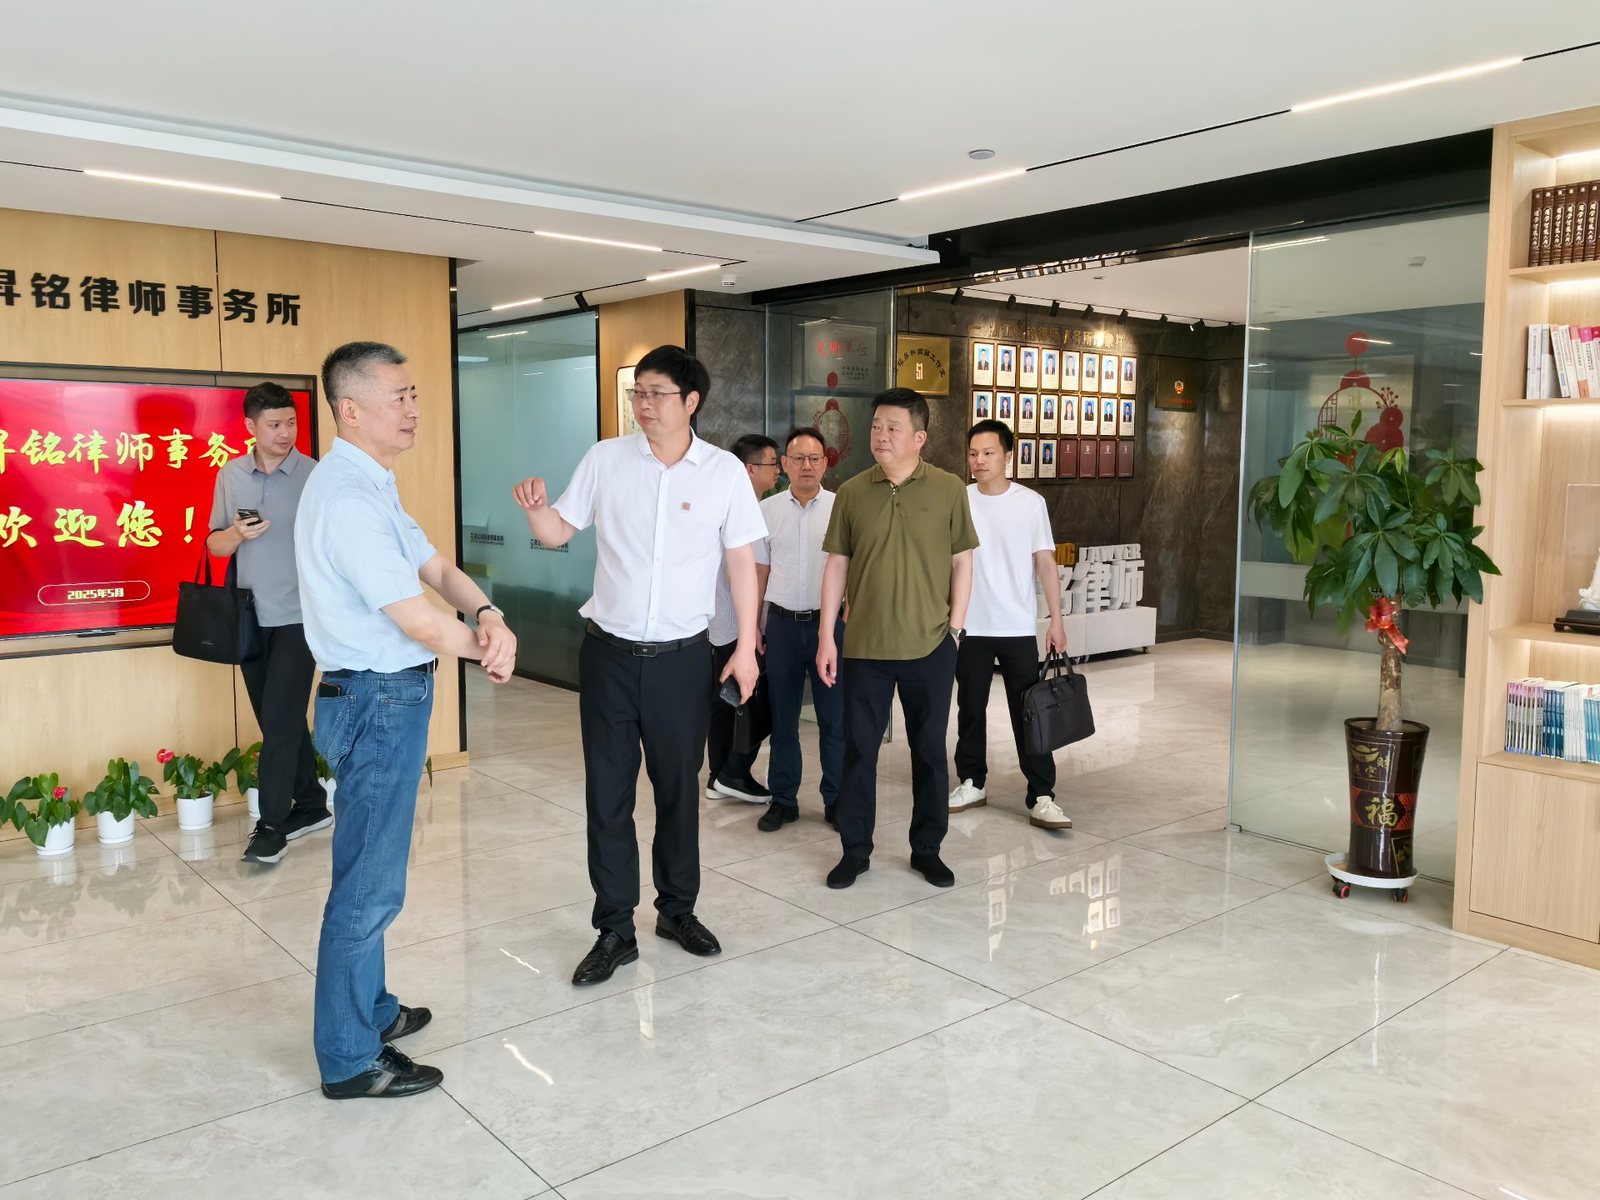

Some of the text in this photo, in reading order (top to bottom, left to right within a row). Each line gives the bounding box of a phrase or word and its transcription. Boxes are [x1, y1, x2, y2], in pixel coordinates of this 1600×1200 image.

[0, 427, 256, 475] 铭律师事务
[1078, 543, 1142, 562] LAWYER
[67, 587, 125, 600] 2025年5月
[1364, 796, 1399, 827] 福
